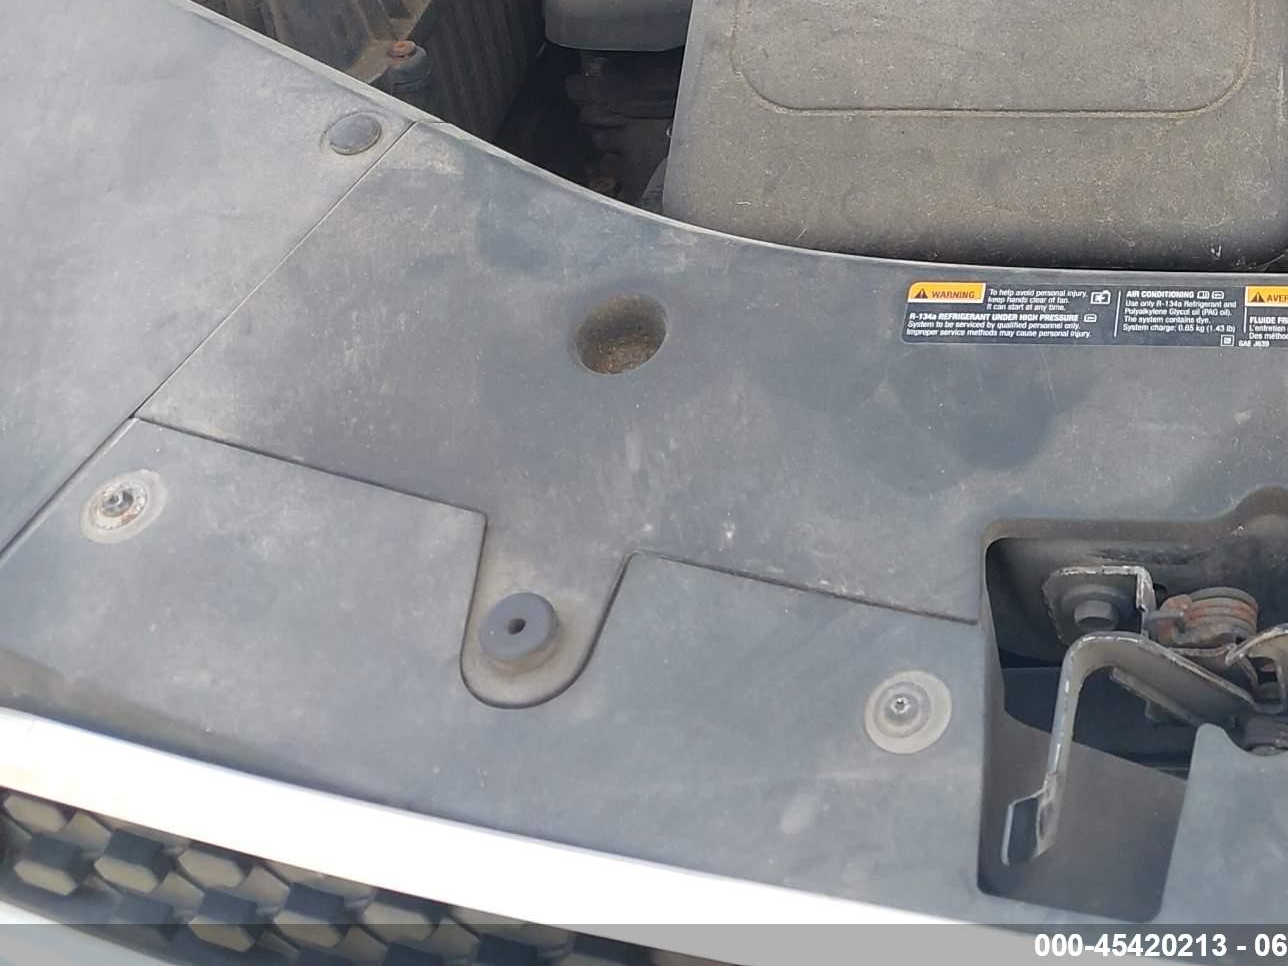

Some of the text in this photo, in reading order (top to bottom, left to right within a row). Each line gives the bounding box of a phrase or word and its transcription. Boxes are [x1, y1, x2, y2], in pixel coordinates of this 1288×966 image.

[932, 291, 975, 299] WARNING
[1184, 300, 1222, 308] Refrigerant
[910, 312, 937, 320] R-134a
[938, 312, 991, 320] REFRIGERANT
[1124, 308, 1168, 316] Polyalkylene
[1168, 308, 1190, 316] Glycol
[1122, 324, 1149, 332] System
[1196, 324, 1206, 333] kg
